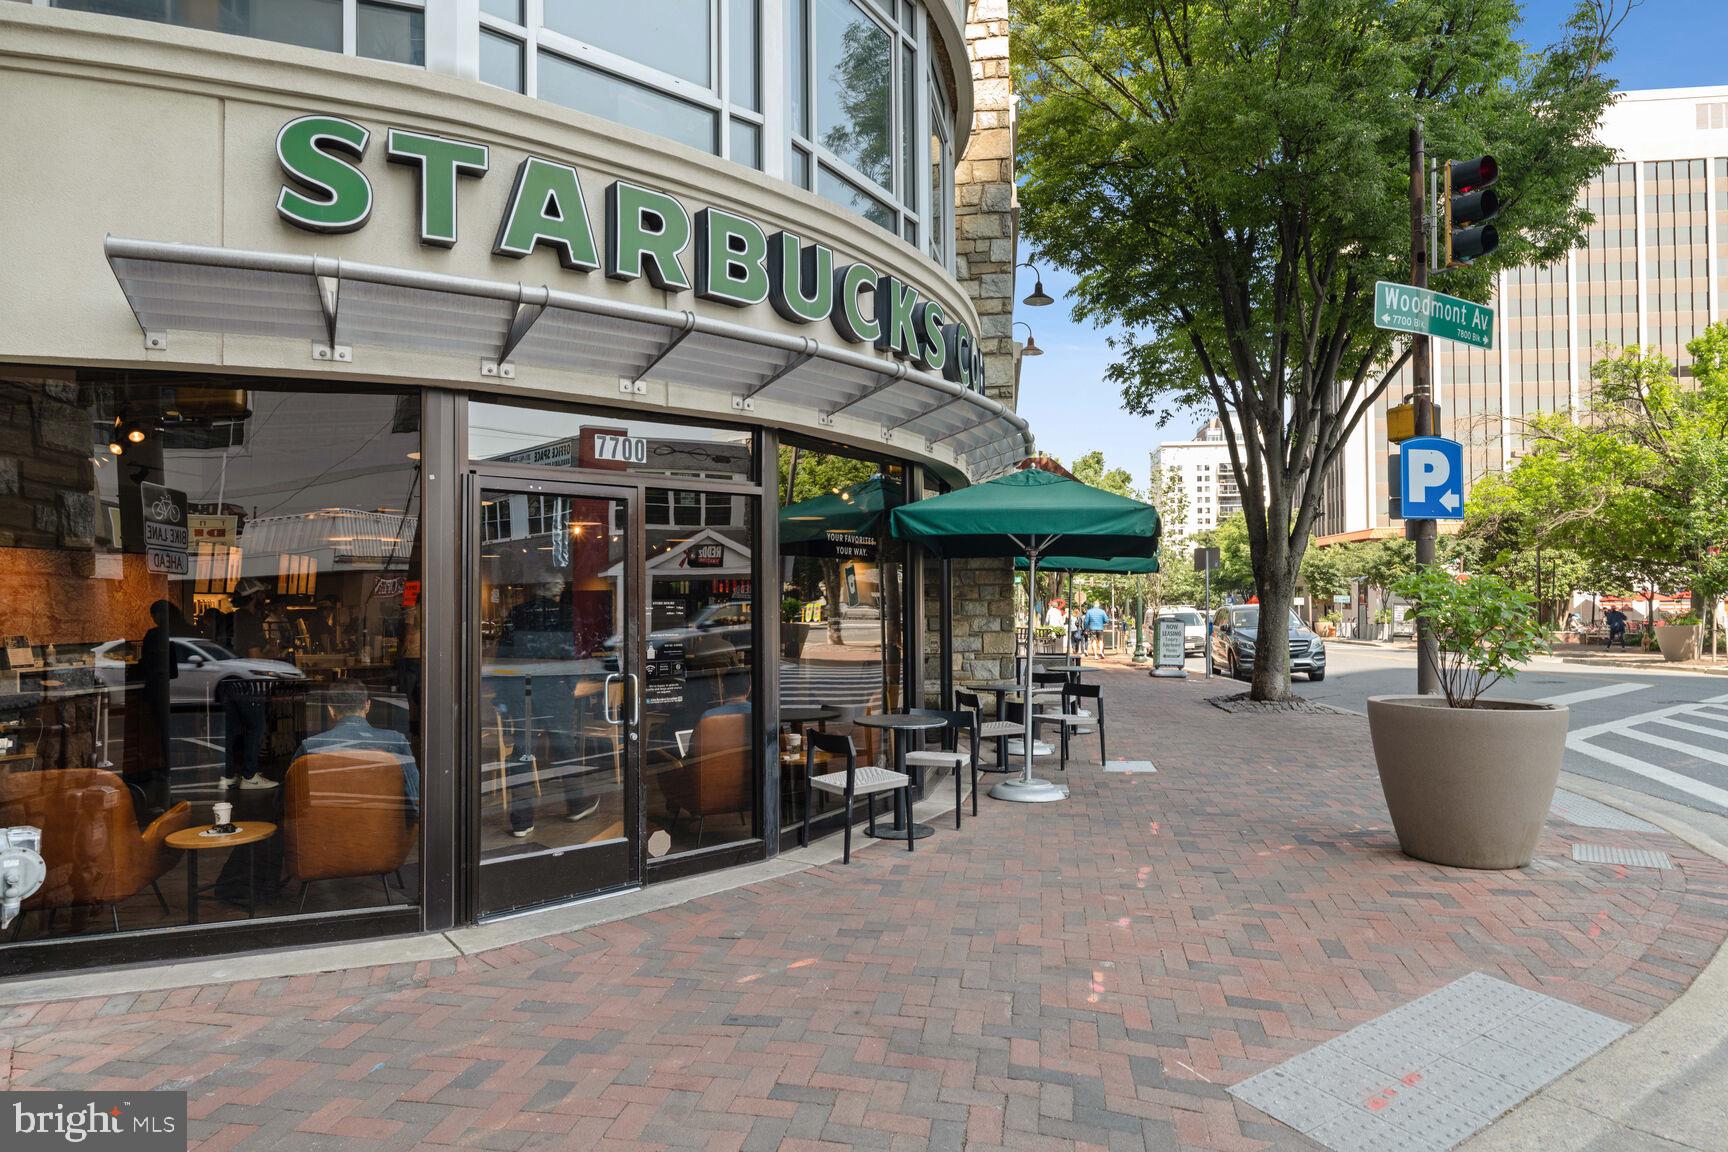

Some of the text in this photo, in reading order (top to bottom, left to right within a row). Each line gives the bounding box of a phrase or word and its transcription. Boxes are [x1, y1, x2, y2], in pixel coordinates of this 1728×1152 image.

[275, 114, 946, 372] STARBUCKS
[1385, 287, 1488, 330] Woodmont Av
[1392, 315, 1412, 326] 7700
[1457, 328, 1471, 340] 7800
[596, 435, 645, 462] 7700
[1408, 449, 1450, 503] P
[826, 532, 844, 542] YOUR
[836, 546, 868, 557] YOUR WAY.
